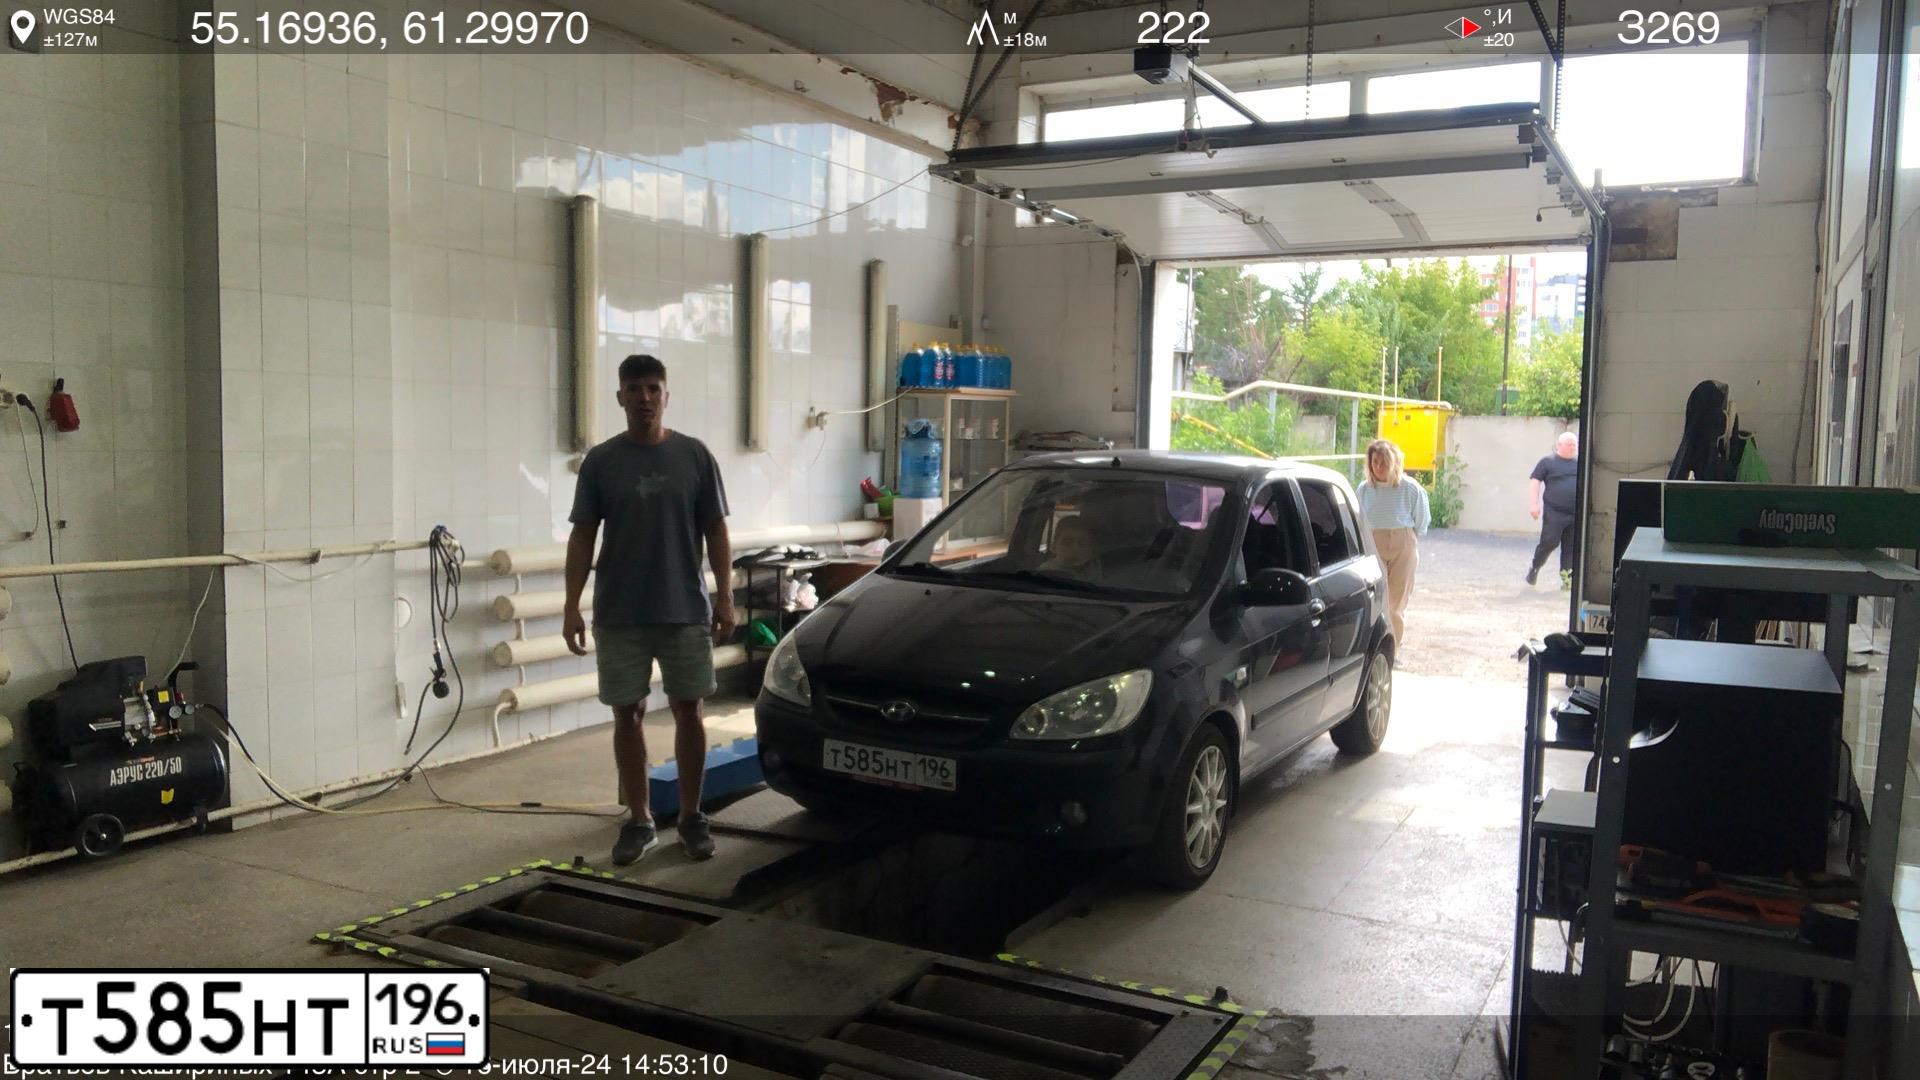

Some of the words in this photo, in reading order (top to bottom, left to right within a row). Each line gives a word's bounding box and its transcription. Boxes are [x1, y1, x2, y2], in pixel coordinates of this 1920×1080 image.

[1759, 509, 1836, 535] SvetoCopy
[109, 763, 144, 787] АЭРУС
[145, 756, 182, 780] 220/50
[830, 745, 912, 779] Т585НТ
[918, 757, 950, 779] 196
